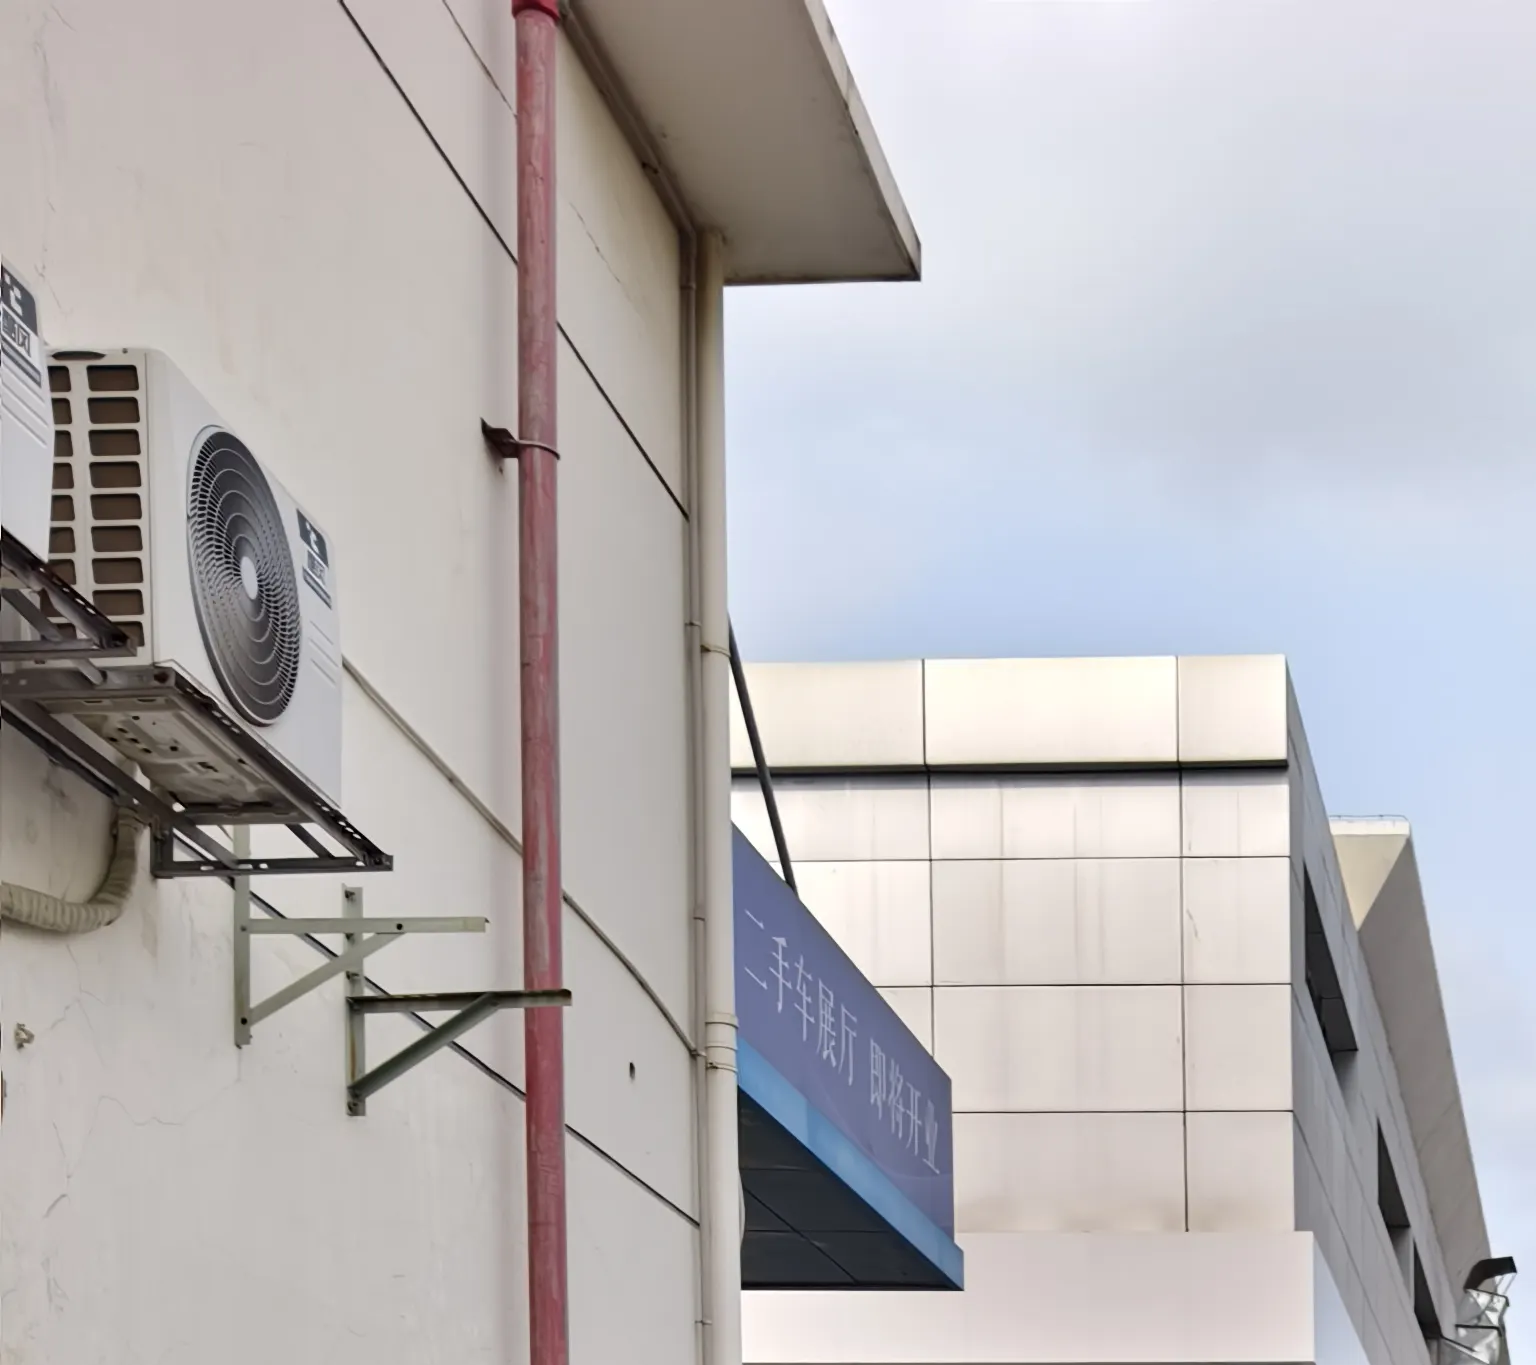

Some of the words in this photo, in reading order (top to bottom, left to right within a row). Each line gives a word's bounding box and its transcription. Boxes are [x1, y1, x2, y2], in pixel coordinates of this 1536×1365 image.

[744, 909, 857, 1087] 二手车展厅
